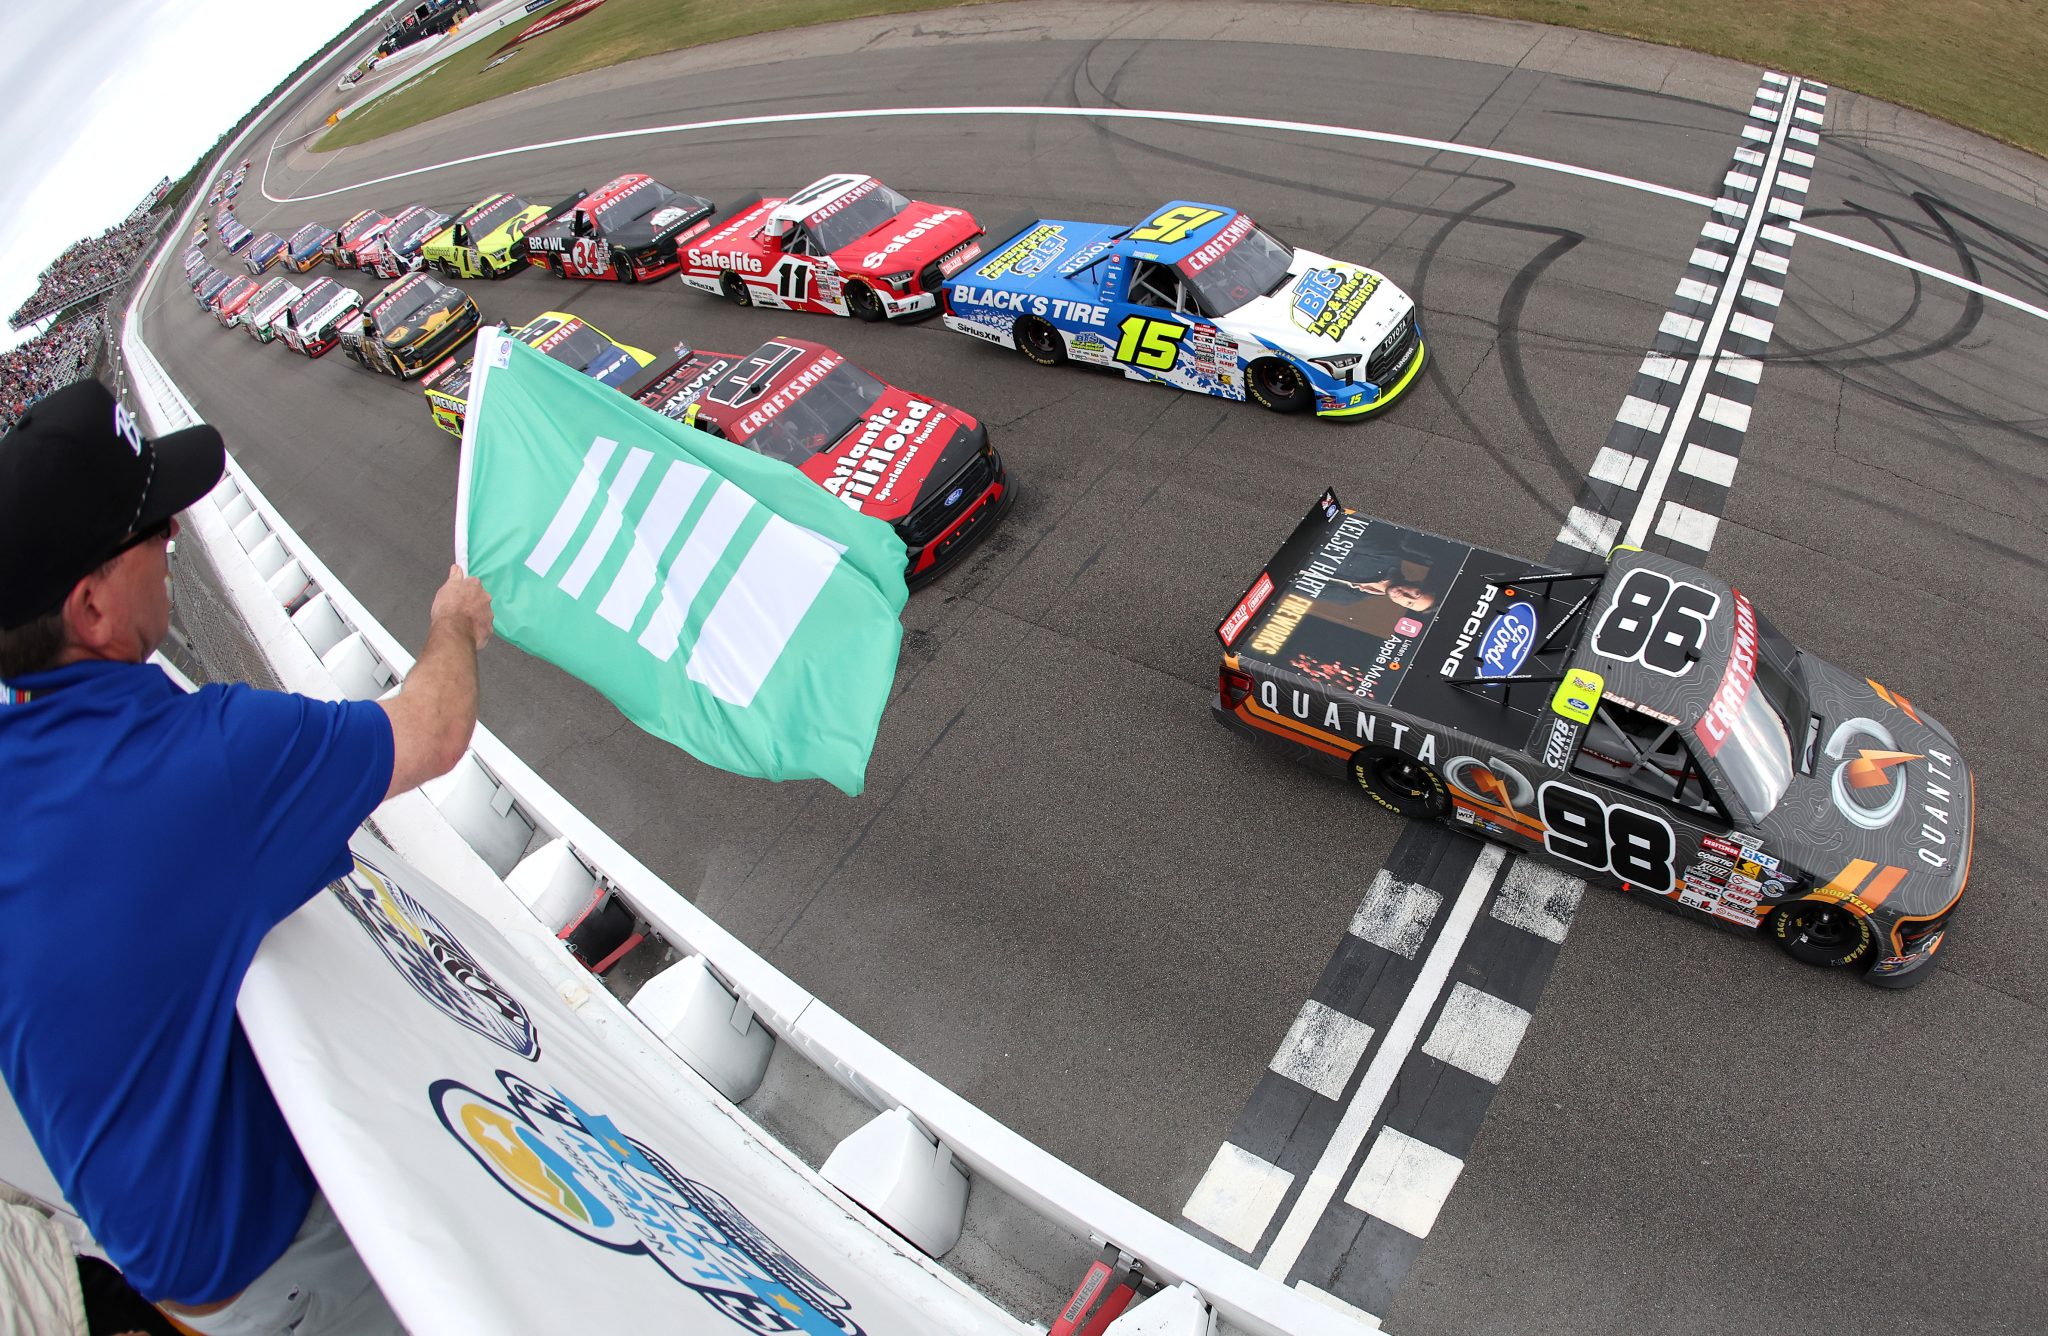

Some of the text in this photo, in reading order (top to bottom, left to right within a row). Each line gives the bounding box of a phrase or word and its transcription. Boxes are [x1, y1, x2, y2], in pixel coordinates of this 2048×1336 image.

[470, 193, 514, 226] CRAFTSMAN
[594, 177, 655, 216] CRAFTSMAN
[812, 180, 878, 224] CRAFTSMAN
[862, 210, 962, 269] Safelite
[1125, 205, 1229, 244] 15
[1188, 214, 1252, 272] CRAFTSMAN
[575, 242, 599, 270] 34
[688, 248, 762, 273] Safelite
[939, 244, 969, 264] TOYOTA
[1061, 241, 1112, 274] TOYOTA
[375, 274, 428, 315] CRAFTSMAN
[779, 263, 809, 299] 11
[1295, 267, 1343, 320] BTS
[910, 301, 919, 311] 11
[953, 284, 1110, 327] BLACK'S TIRE
[957, 322, 1001, 343] SiriusXM
[1113, 313, 1192, 374] 15
[1384, 318, 1408, 349] TOYOTA
[1392, 347, 1414, 372] TUNDRA
[432, 395, 467, 414] MENAR
[740, 356, 837, 434] CRAFTSMAN
[1349, 393, 1363, 406] 15
[822, 406, 899, 495] Atlantic
[874, 411, 947, 502] Specialized Hauling
[1319, 516, 1370, 565] KELSEY
[1250, 580, 1272, 611] CRAFTSMAN
[1295, 560, 1338, 599] HART
[1221, 604, 1247, 640] THE TRIP
[1251, 593, 1313, 656] FIREWORKS
[1440, 584, 1499, 678] RACING
[1591, 567, 1720, 678] 98
[1400, 639, 1413, 657] Listen
[1485, 614, 1530, 671] Ford
[1355, 634, 1402, 698] Apple Music
[1704, 600, 1756, 742] CRAFTSMAN
[1261, 681, 1437, 767] QUANTA
[1568, 699, 1589, 710] Ford
[1602, 691, 1681, 726] Jake Garcia
[1546, 719, 1569, 769] CURB
[1457, 811, 1474, 821] WIX
[1917, 748, 1953, 868] QUANTA
[1538, 779, 1675, 896] 98
[1703, 839, 1738, 855] CRAFTSMAN
[1742, 848, 1777, 866] SKF
[1697, 851, 1734, 867] COMETIC
[1699, 861, 1728, 876] KLOTZ
[1686, 876, 1721, 893] tilton
[1686, 885, 1718, 901] KOOKS
[1813, 887, 1875, 915] GOODYEAR
[1720, 901, 1758, 918] JESEL
[1727, 912, 1757, 926] brembo
[1776, 911, 1790, 938] EAGLE
[1843, 914, 1871, 964] GOODYEAR
[556, 1135, 641, 1223] Education
[560, 1124, 737, 1285] Lottery
[621, 1159, 778, 1284] 250
[720, 1224, 840, 1322] ROCKINGHAM
[1065, 1270, 1104, 1321] SMITH FENCE
